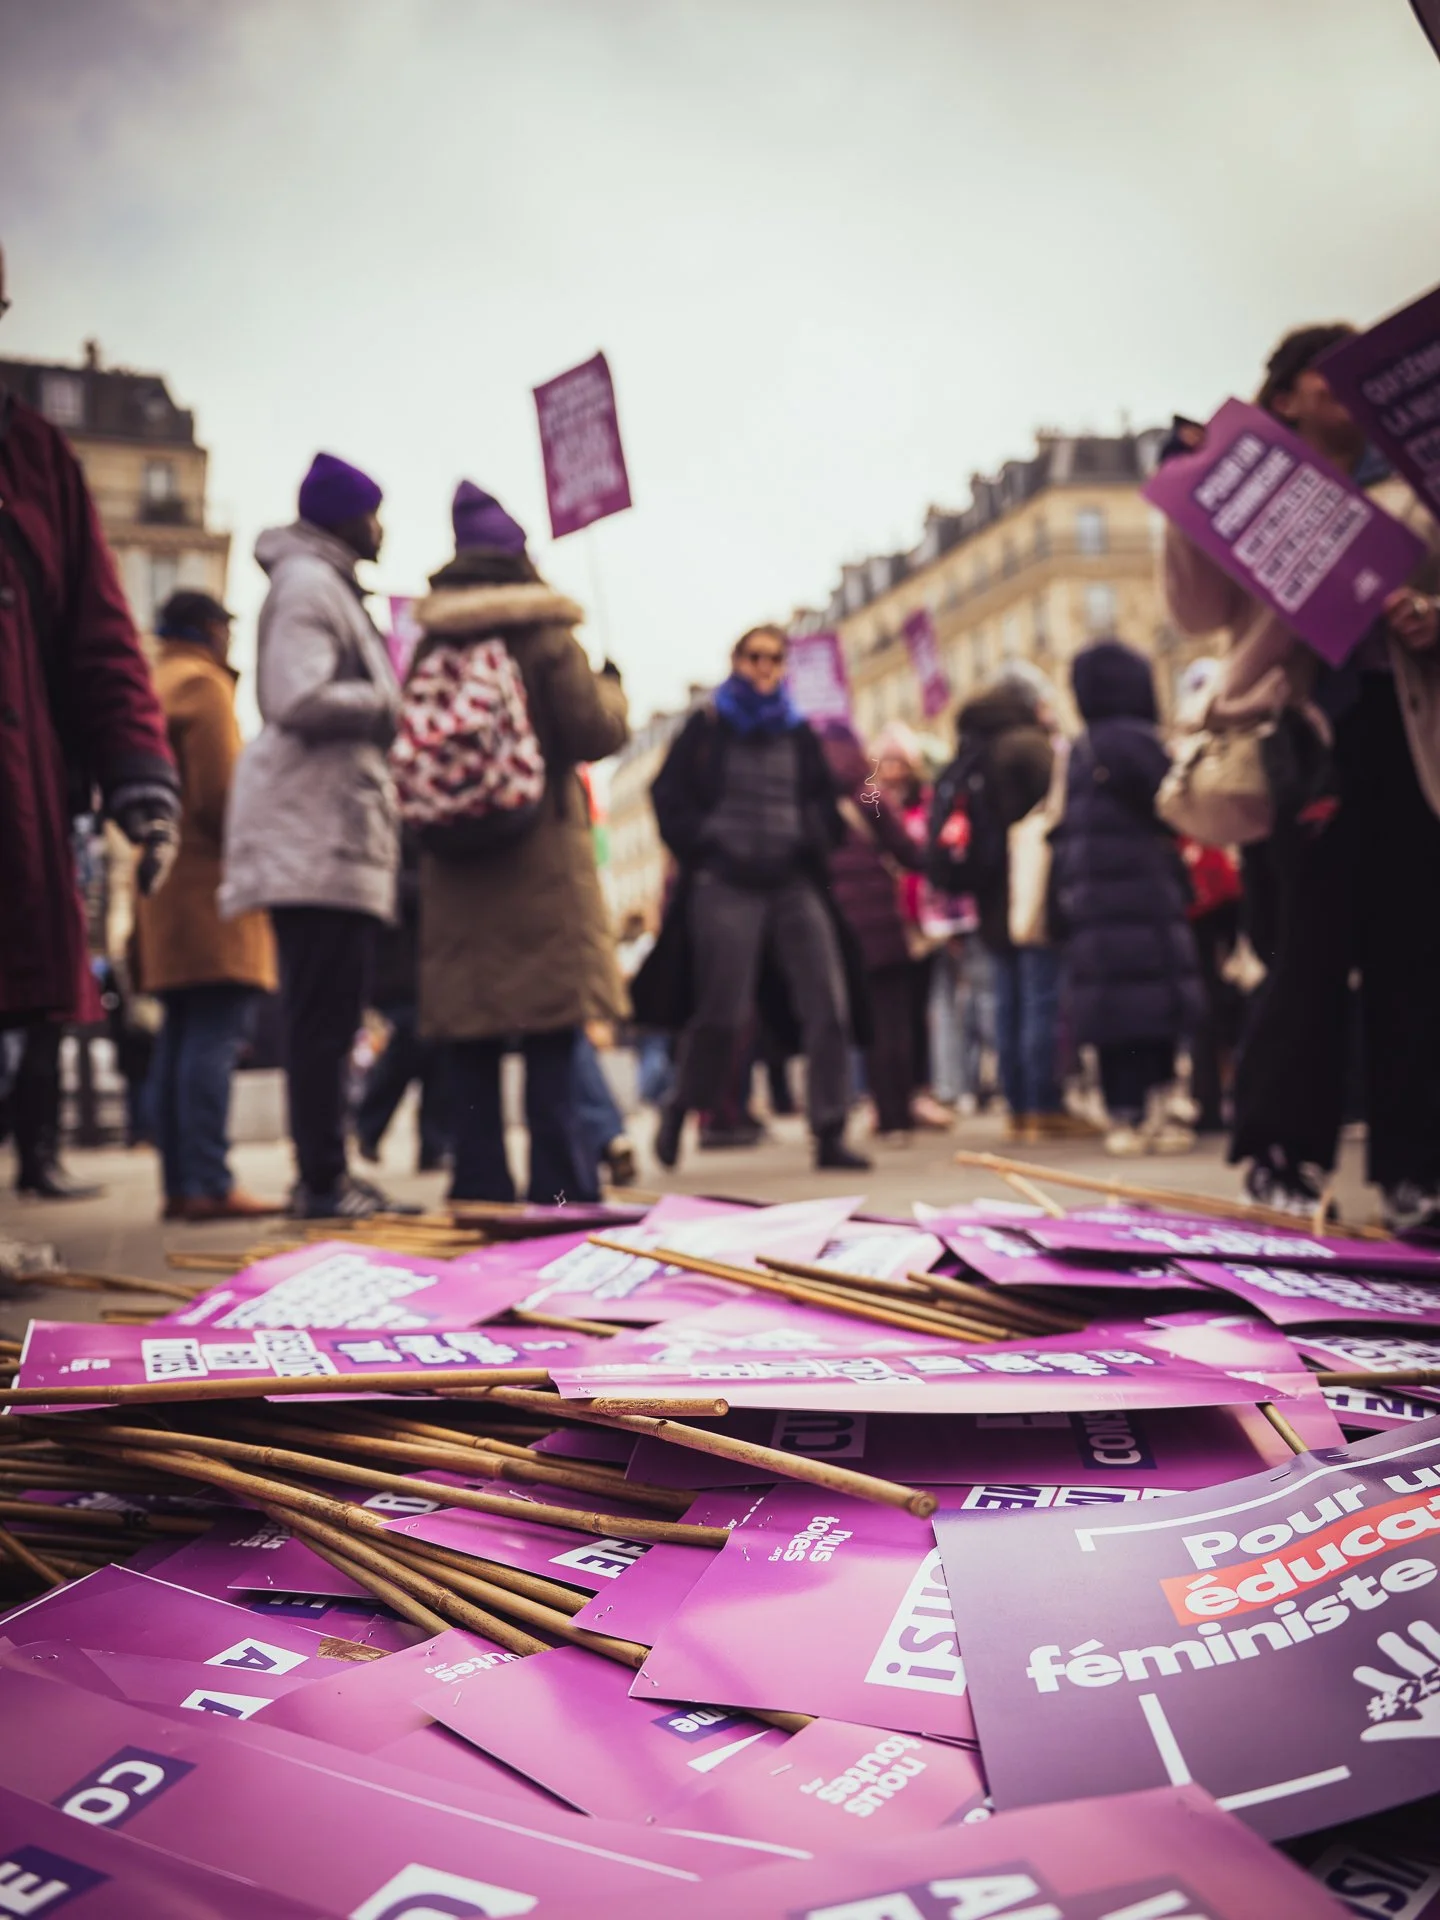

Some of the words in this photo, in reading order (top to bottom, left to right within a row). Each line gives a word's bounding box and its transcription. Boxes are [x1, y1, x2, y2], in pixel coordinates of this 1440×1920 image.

[783, 1516, 840, 1561] toutes
[808, 1530, 853, 1562] nous
[1182, 1484, 1367, 1569] Pour
[1383, 1462, 1440, 1494] u
[1026, 1558, 1438, 1693] féministe
[816, 1735, 922, 1805] toutes
[844, 1756, 927, 1817] nous
